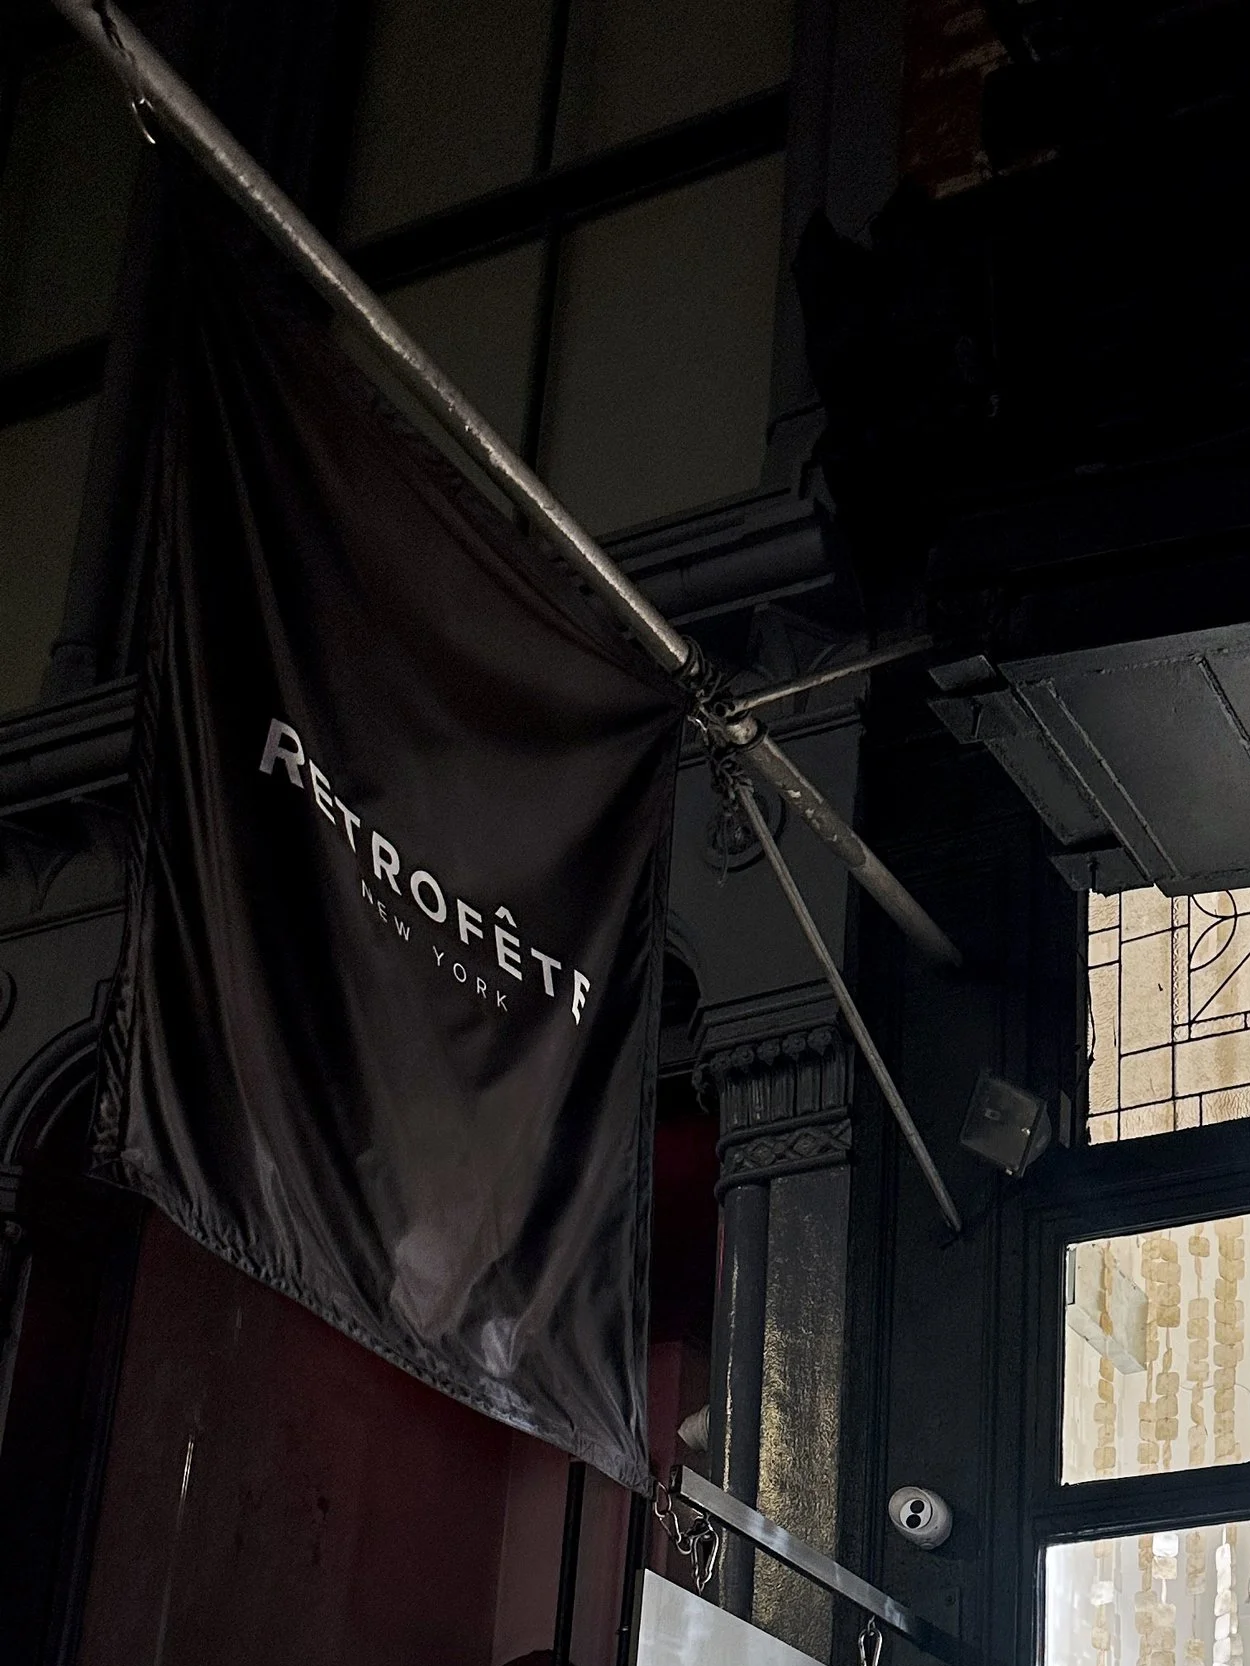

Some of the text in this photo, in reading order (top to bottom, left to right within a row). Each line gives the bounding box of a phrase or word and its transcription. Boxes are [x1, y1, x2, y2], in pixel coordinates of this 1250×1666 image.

[259, 718, 591, 1026] RETROFÊTE
[361, 879, 508, 1012] NEW YORK
